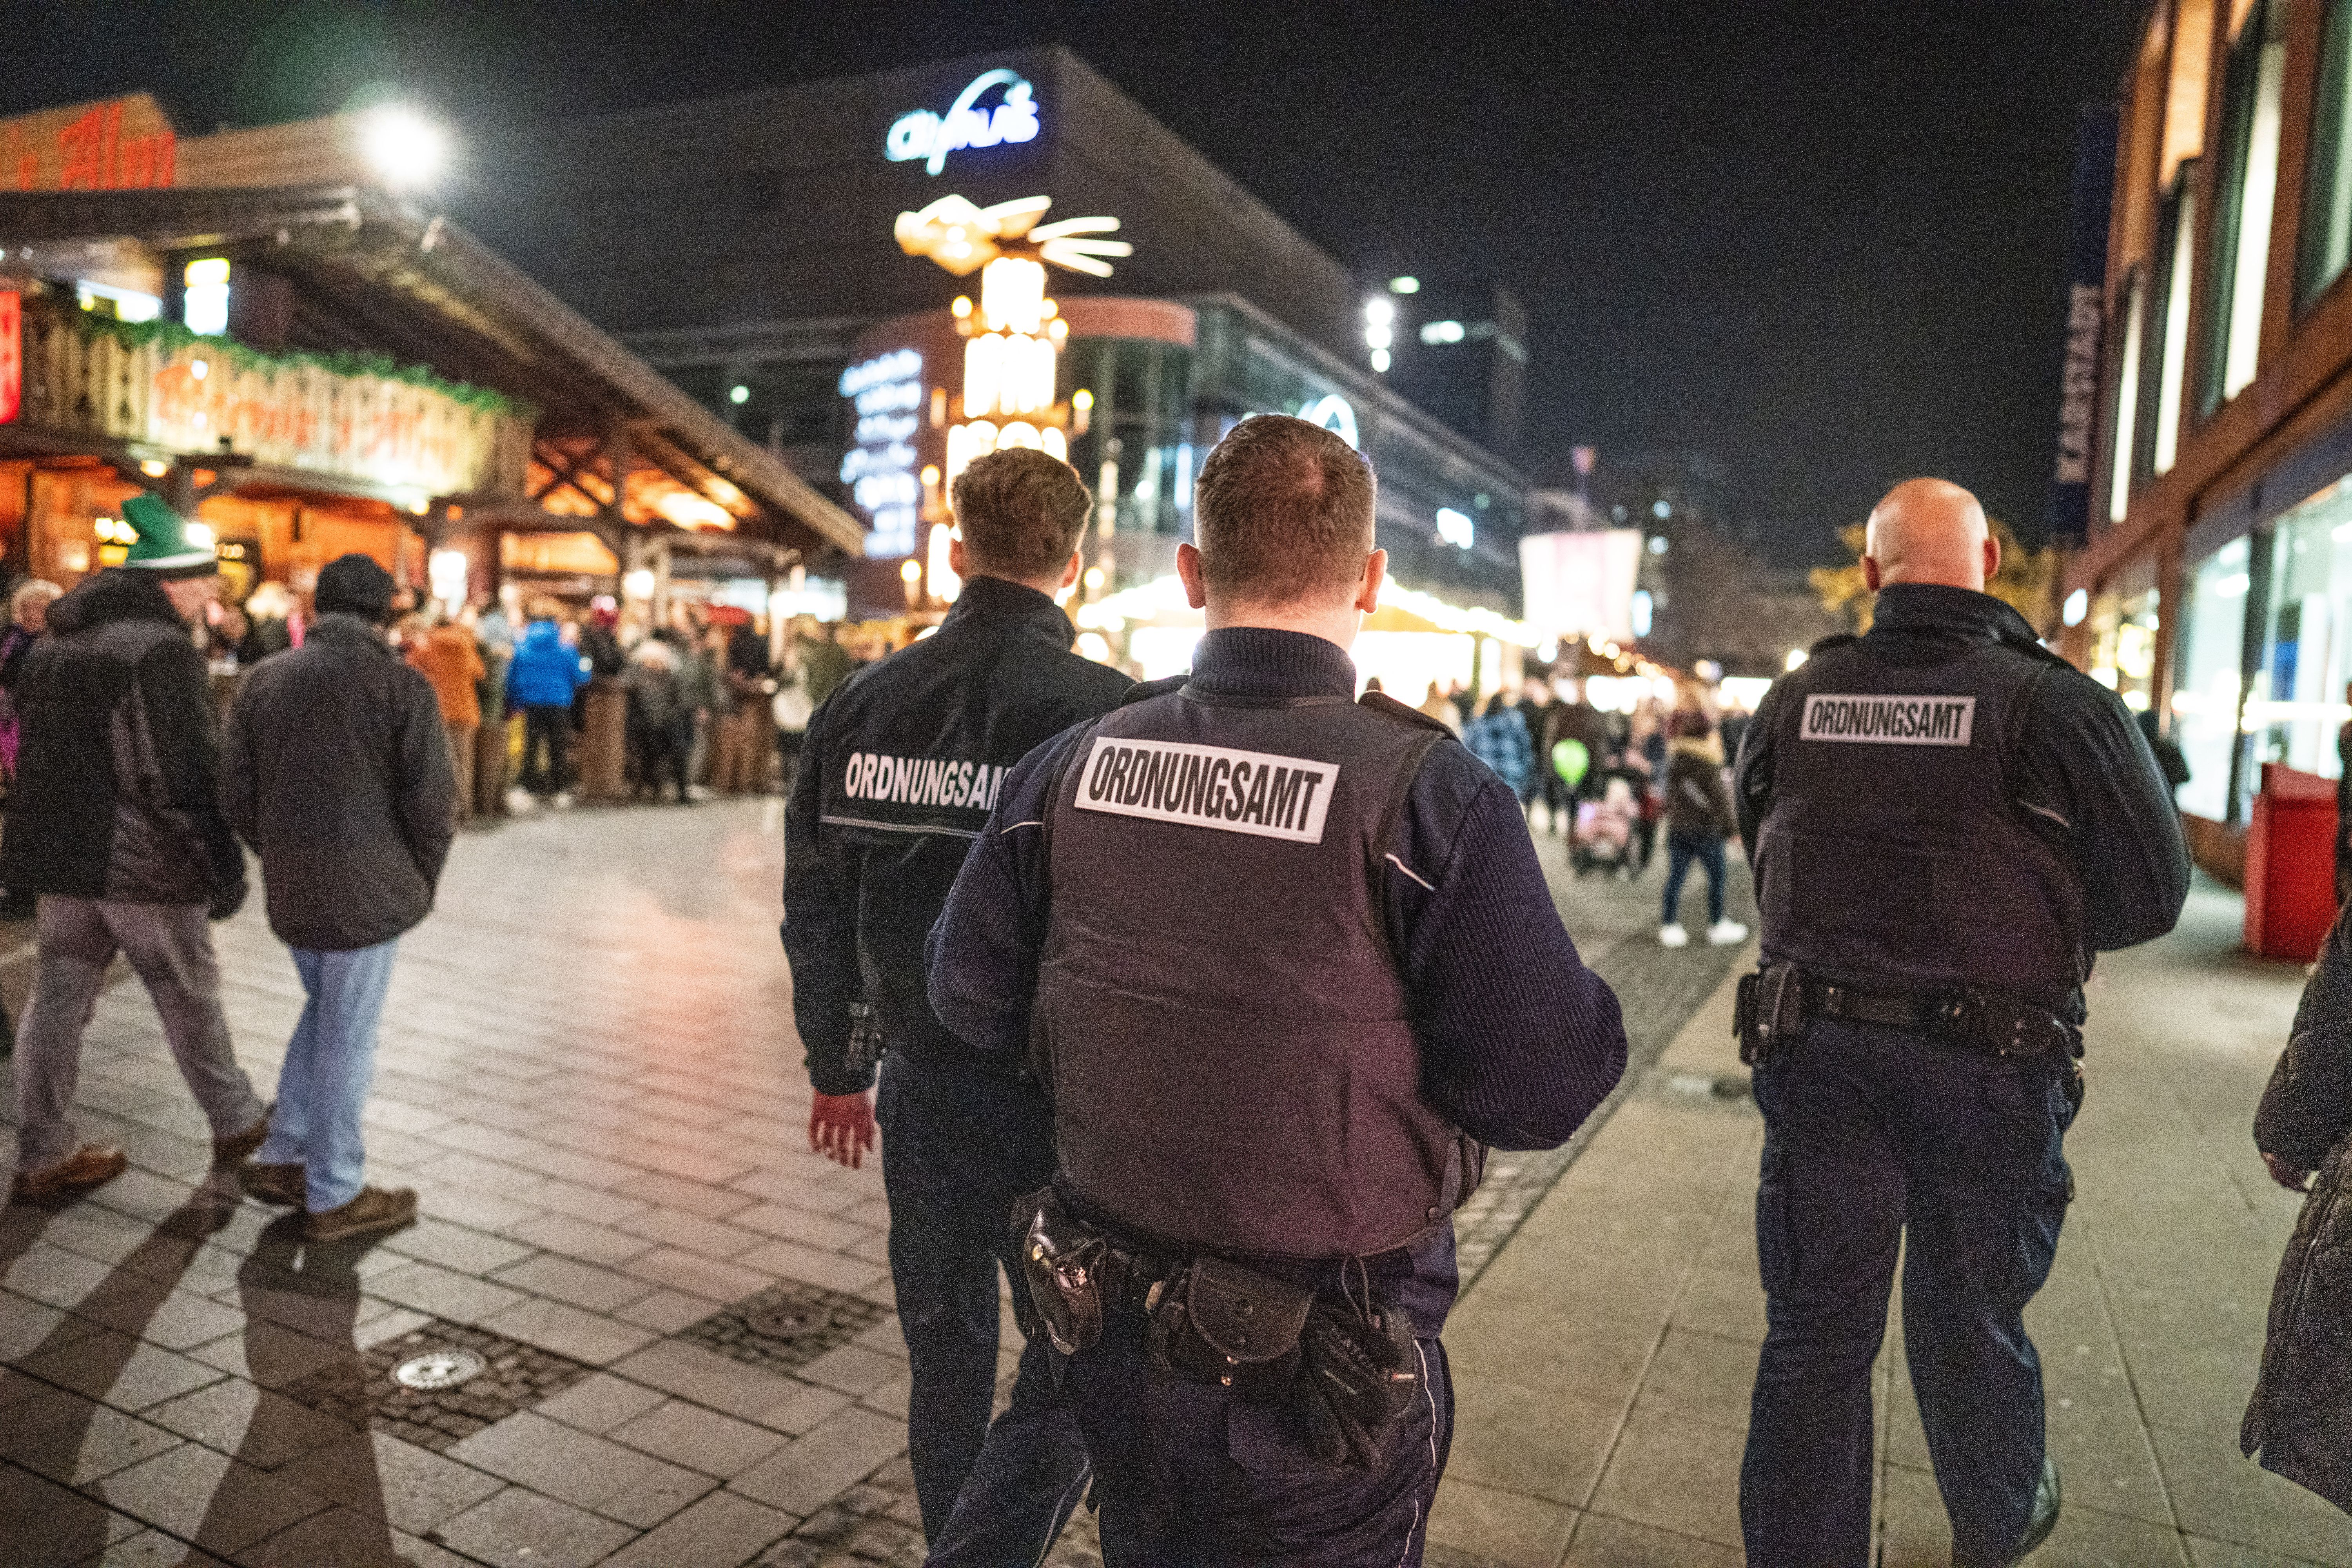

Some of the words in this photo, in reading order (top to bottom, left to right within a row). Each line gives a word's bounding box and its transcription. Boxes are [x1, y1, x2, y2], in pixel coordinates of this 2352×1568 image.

[1809, 700, 1966, 739] ORDNUNGSAMT
[846, 751, 1013, 811] ORDNUNGSAM
[1089, 745, 1324, 831] ORDNUNGSAMT
